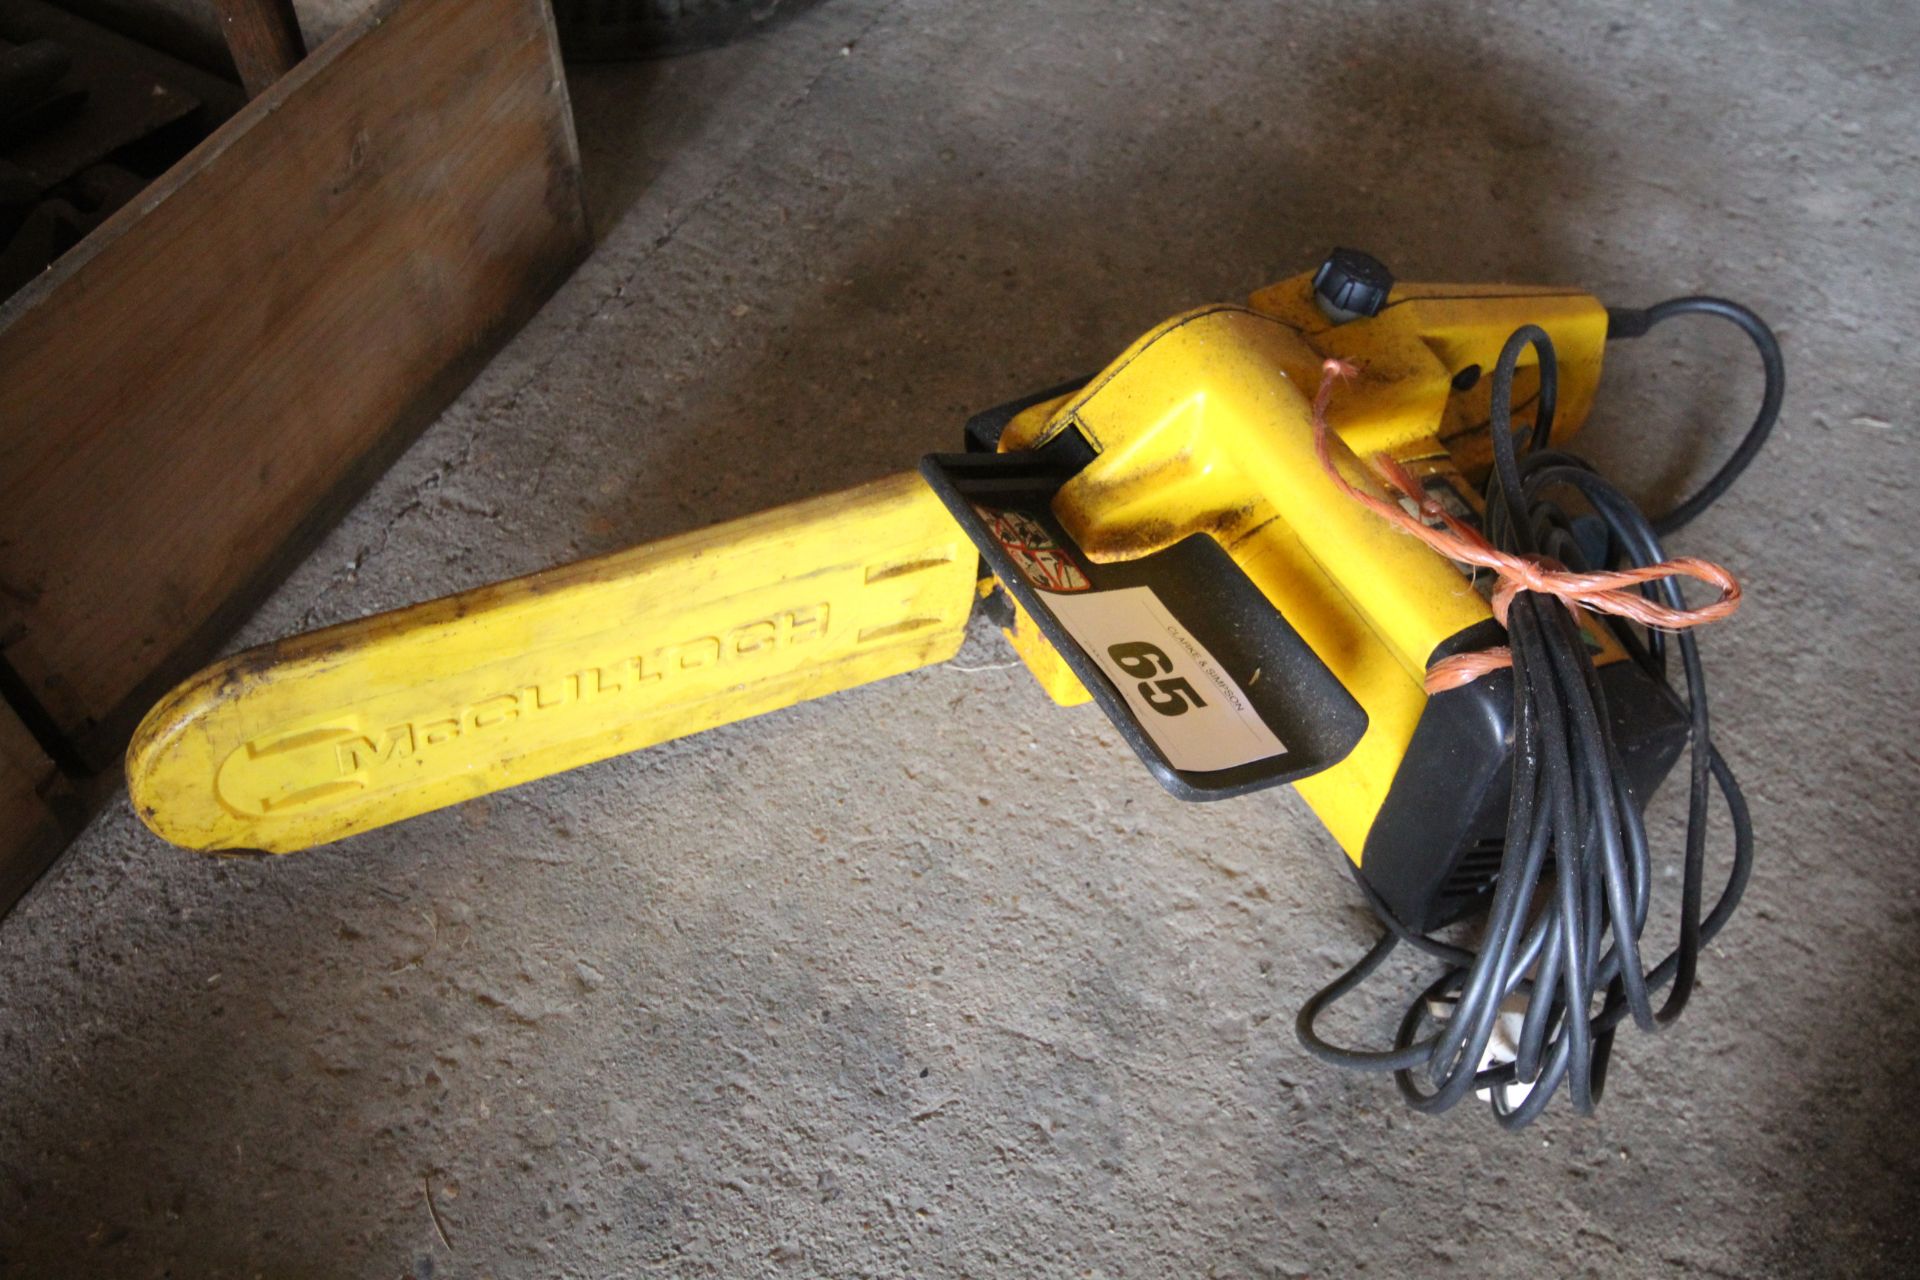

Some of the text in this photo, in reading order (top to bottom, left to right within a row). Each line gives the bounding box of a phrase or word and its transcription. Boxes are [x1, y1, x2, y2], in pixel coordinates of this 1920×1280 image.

[1107, 641, 1208, 717] 65
[1167, 625, 1245, 711] CLARKE & SIMPSON
